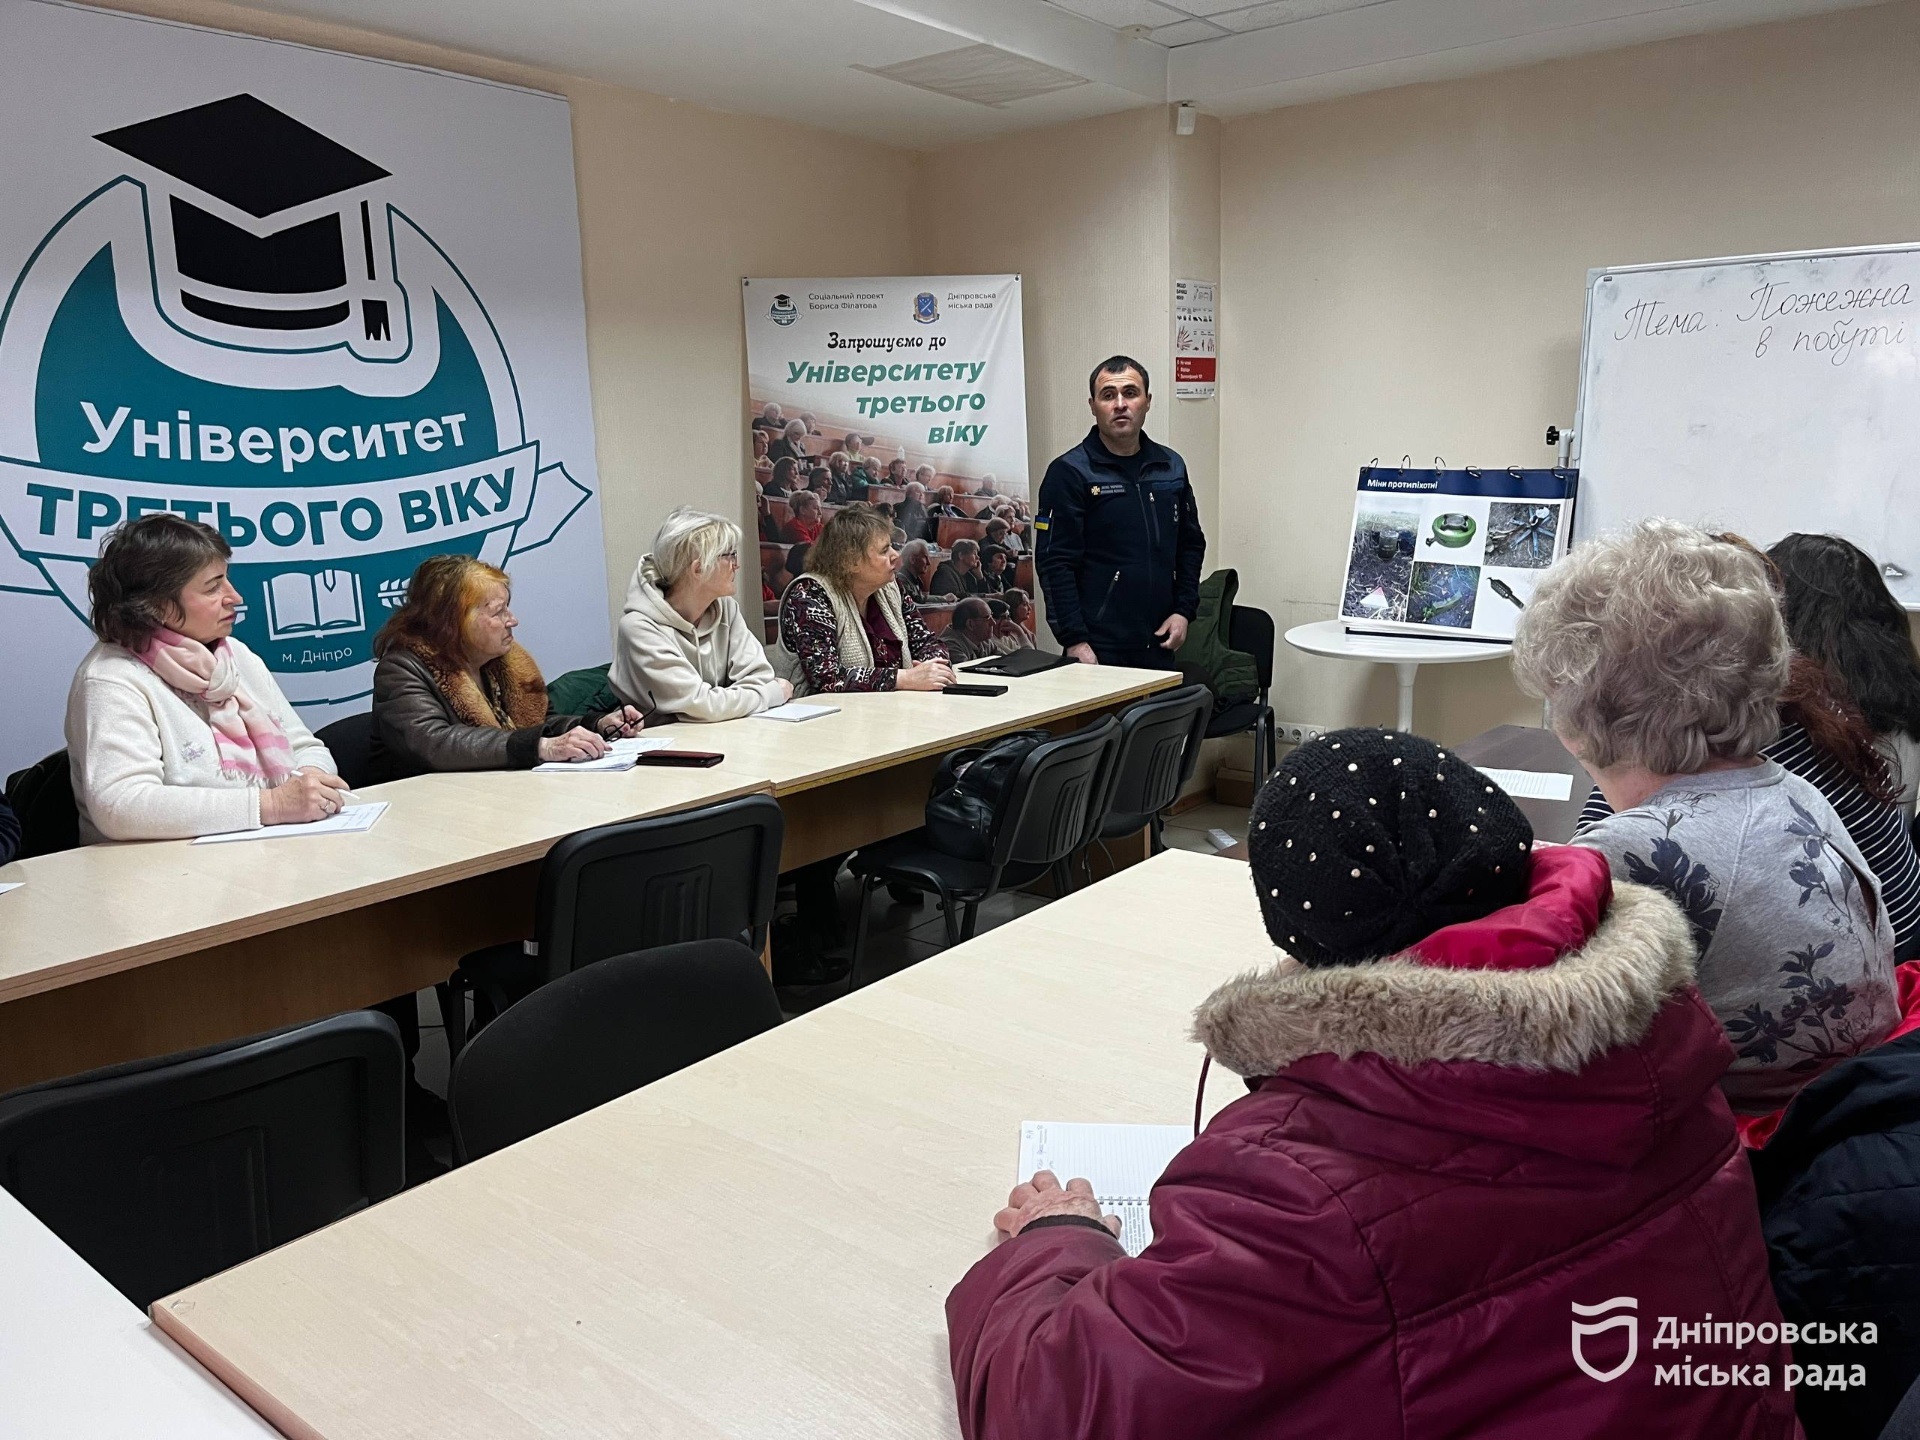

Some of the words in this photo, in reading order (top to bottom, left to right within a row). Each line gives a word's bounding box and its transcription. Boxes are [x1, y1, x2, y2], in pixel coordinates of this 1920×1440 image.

[809, 302, 839, 310] Бориса
[1736, 282, 1914, 322] Пожежна
[827, 331, 924, 353] Запрошуємо
[928, 336, 947, 351] до
[1755, 325, 1774, 358] в
[1793, 317, 1907, 367] побуті
[786, 360, 987, 386] Університету
[856, 392, 986, 419] третього
[80, 400, 468, 473] Університет
[927, 421, 988, 447] віку
[1367, 478, 1387, 488] Міни
[1388, 480, 1439, 490] протипіхотні
[398, 466, 516, 535] ВІКУ
[282, 653, 297, 664] м.
[301, 646, 354, 665] Дніпро
